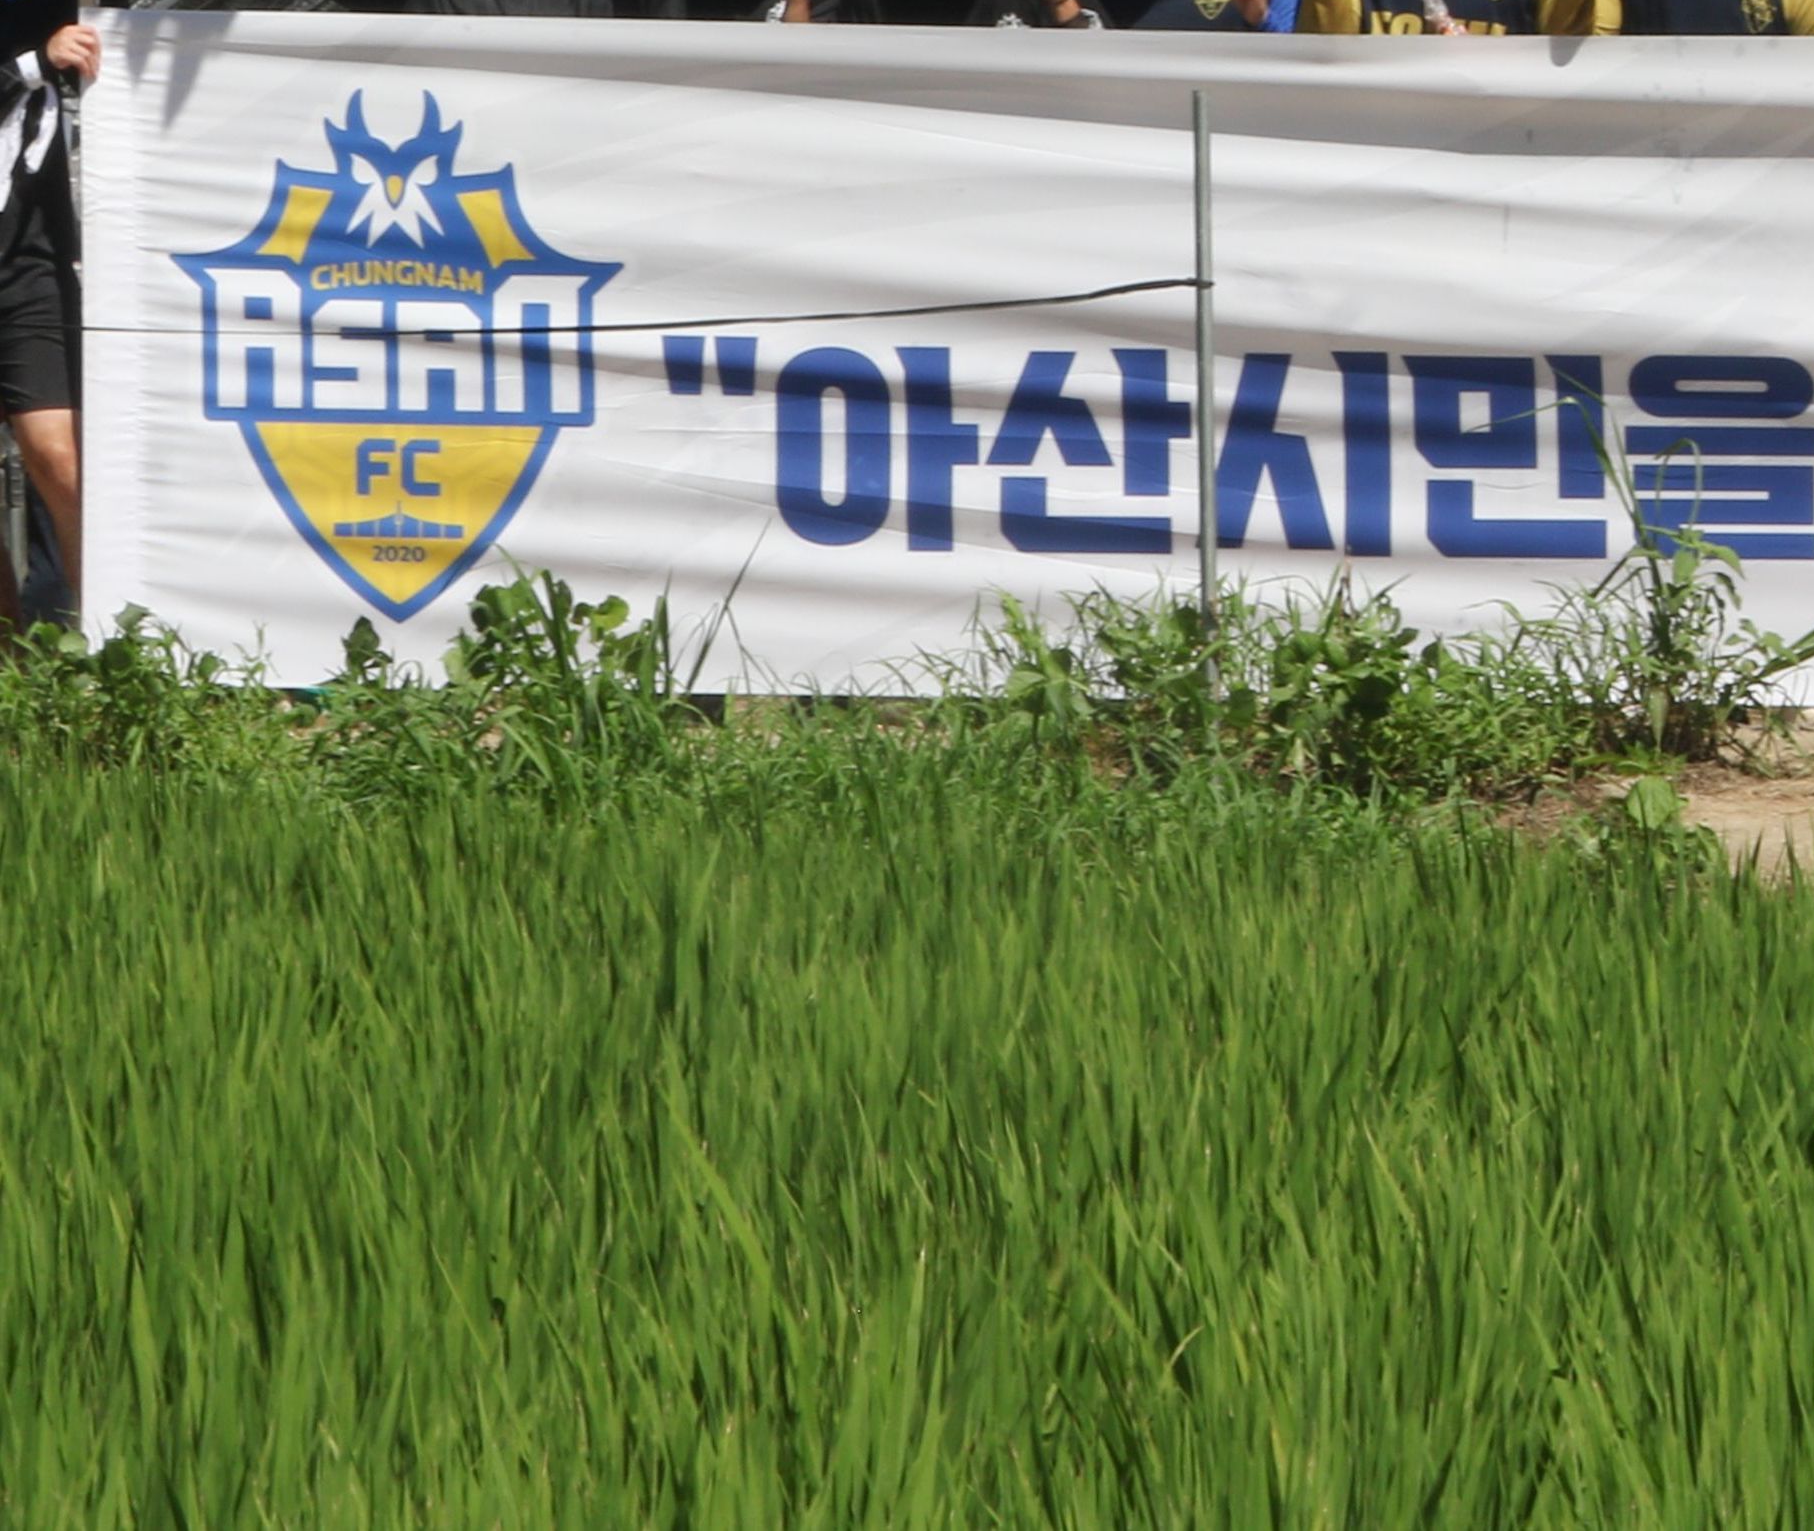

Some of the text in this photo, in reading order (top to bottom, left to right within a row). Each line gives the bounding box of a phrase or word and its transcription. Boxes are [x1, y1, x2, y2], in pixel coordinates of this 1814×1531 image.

[310, 263, 484, 293] CHUNGNAM
[203, 266, 591, 414] ASAN
[356, 439, 441, 497] FC
[371, 544, 426, 563] 2020
